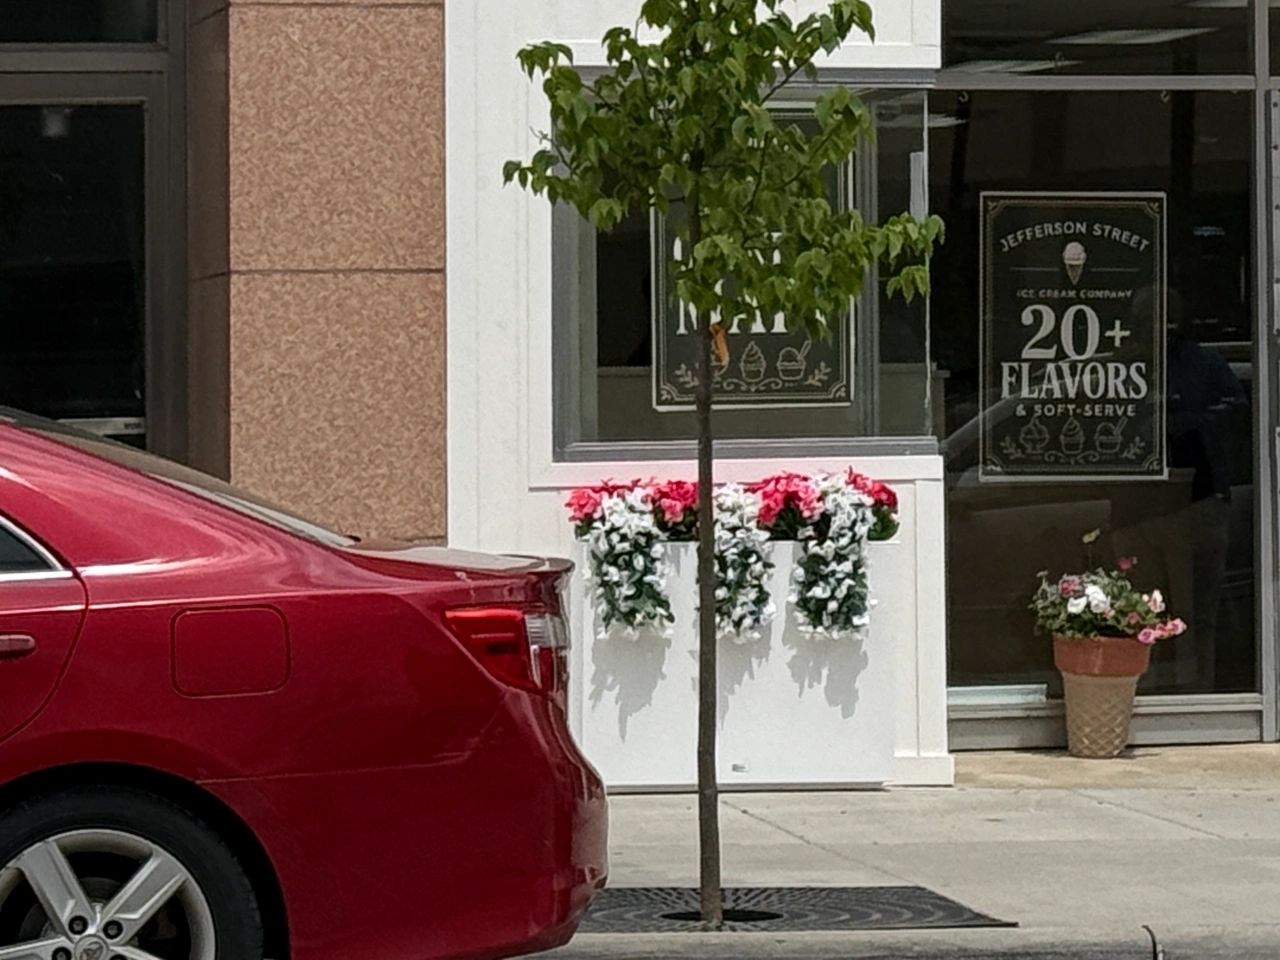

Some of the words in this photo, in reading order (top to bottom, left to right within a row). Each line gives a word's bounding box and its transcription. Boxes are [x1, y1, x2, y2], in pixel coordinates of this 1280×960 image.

[1001, 221, 1087, 253] JEFFERSON
[1092, 223, 1150, 252] STREET
[1020, 304, 1131, 360] 20+
[1000, 361, 1148, 400] FLAVORS
[1015, 403, 1027, 417] &
